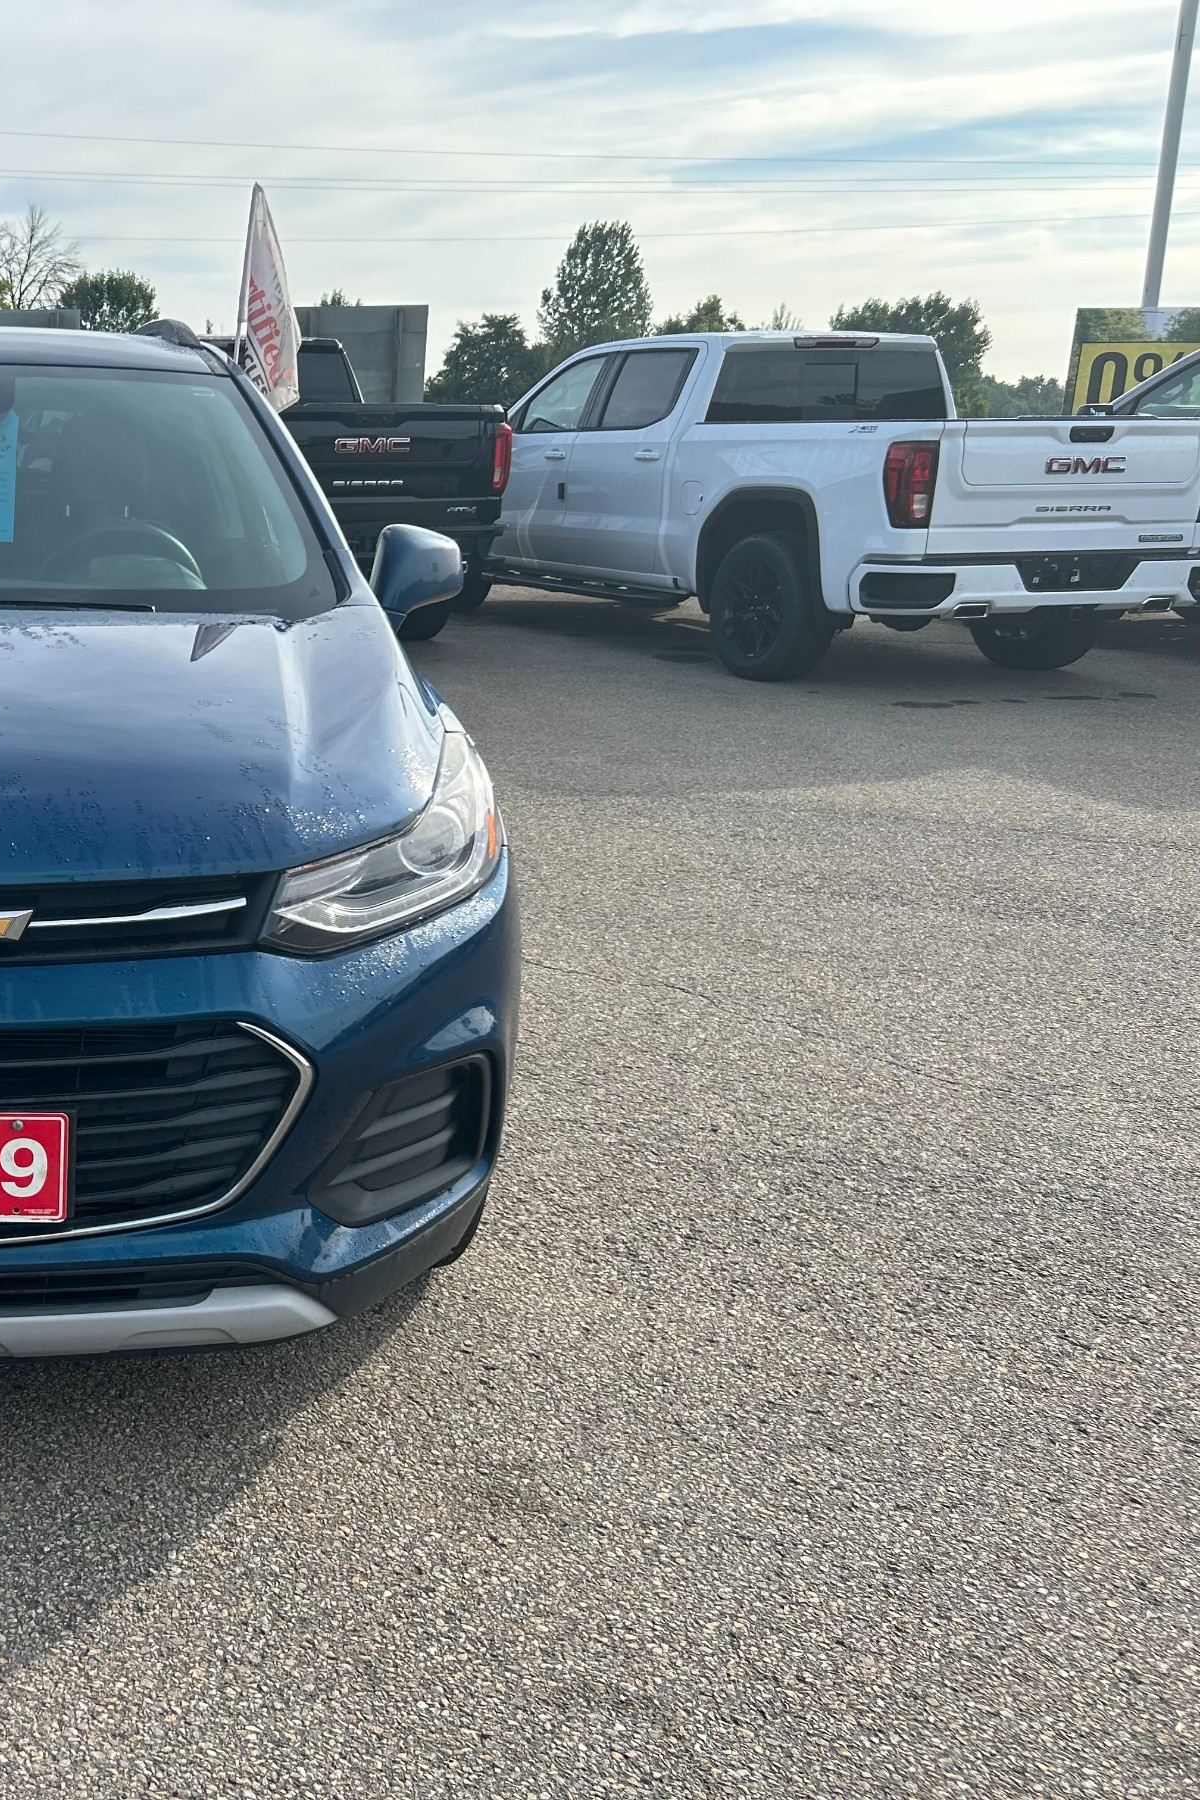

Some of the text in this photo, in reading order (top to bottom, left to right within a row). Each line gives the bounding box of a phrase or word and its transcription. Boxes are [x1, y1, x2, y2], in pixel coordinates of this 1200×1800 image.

[335, 437, 411, 453] GMC
[1044, 455, 1127, 475] GMC
[1035, 505, 1112, 513] SIERRA
